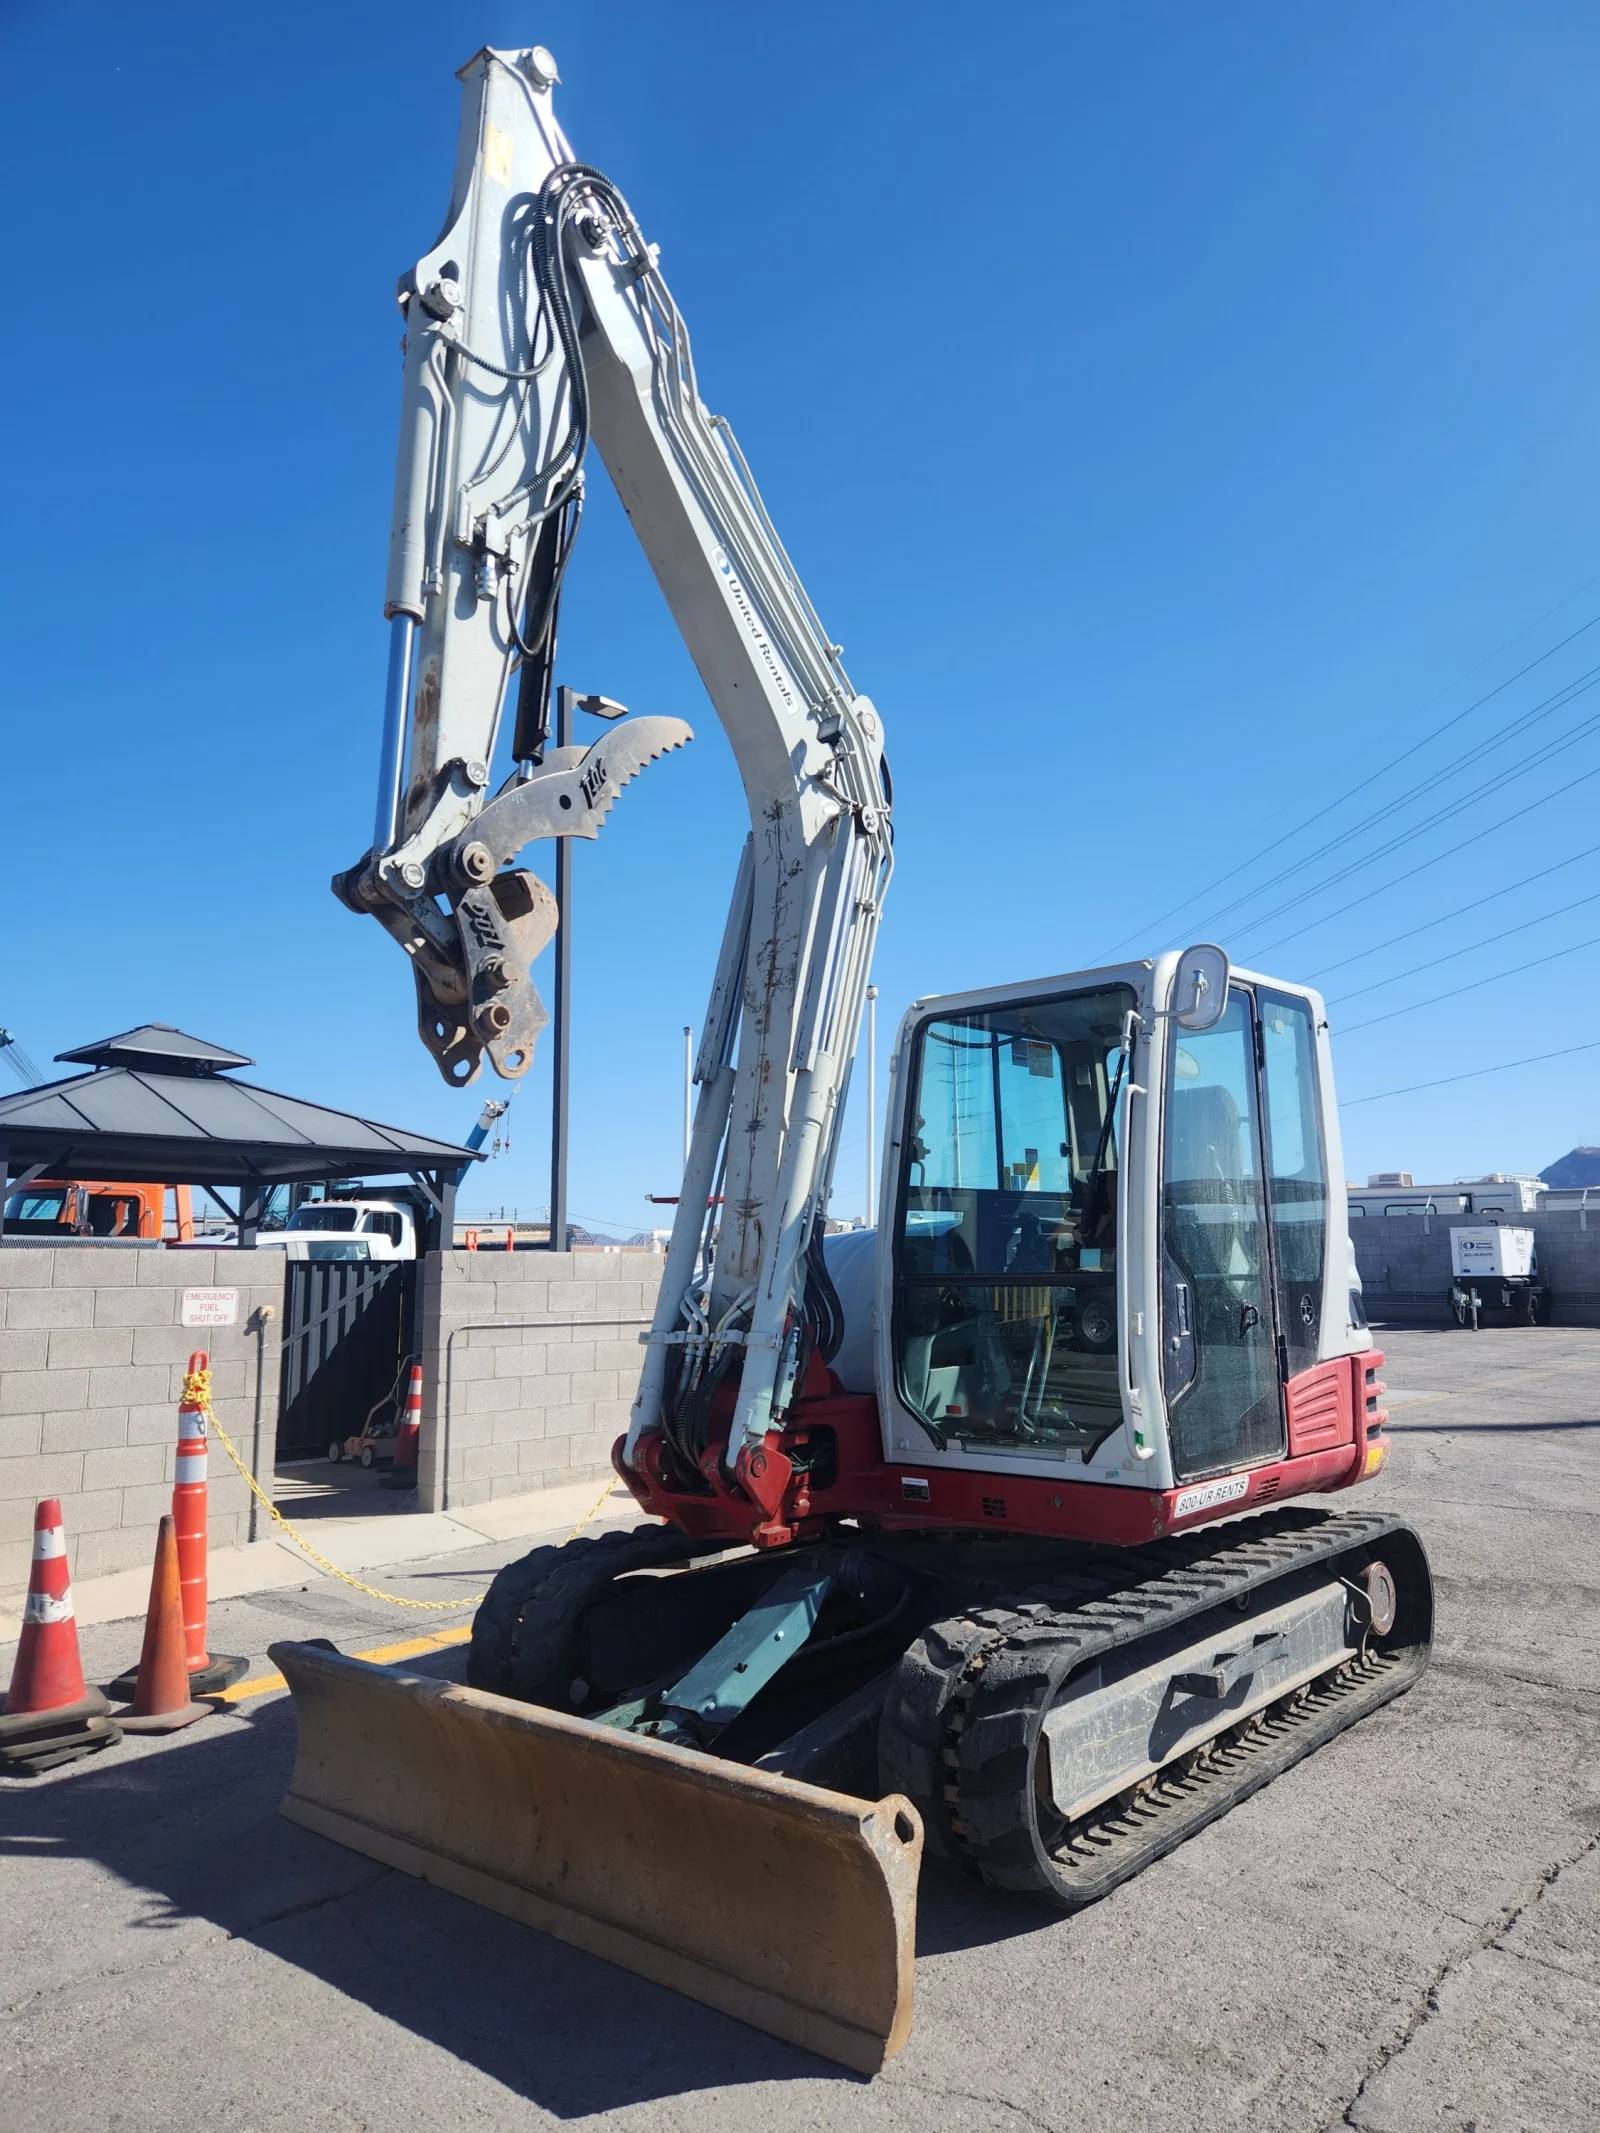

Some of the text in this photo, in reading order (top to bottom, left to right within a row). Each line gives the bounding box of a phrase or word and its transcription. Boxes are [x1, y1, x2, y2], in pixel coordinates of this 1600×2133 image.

[728, 579, 795, 707] United Rentals
[185, 1293, 235, 1301] EMERGENCY
[189, 1314, 229, 1322] SHUT OFF
[1179, 1480, 1245, 1512] 800-UR-RENTS
